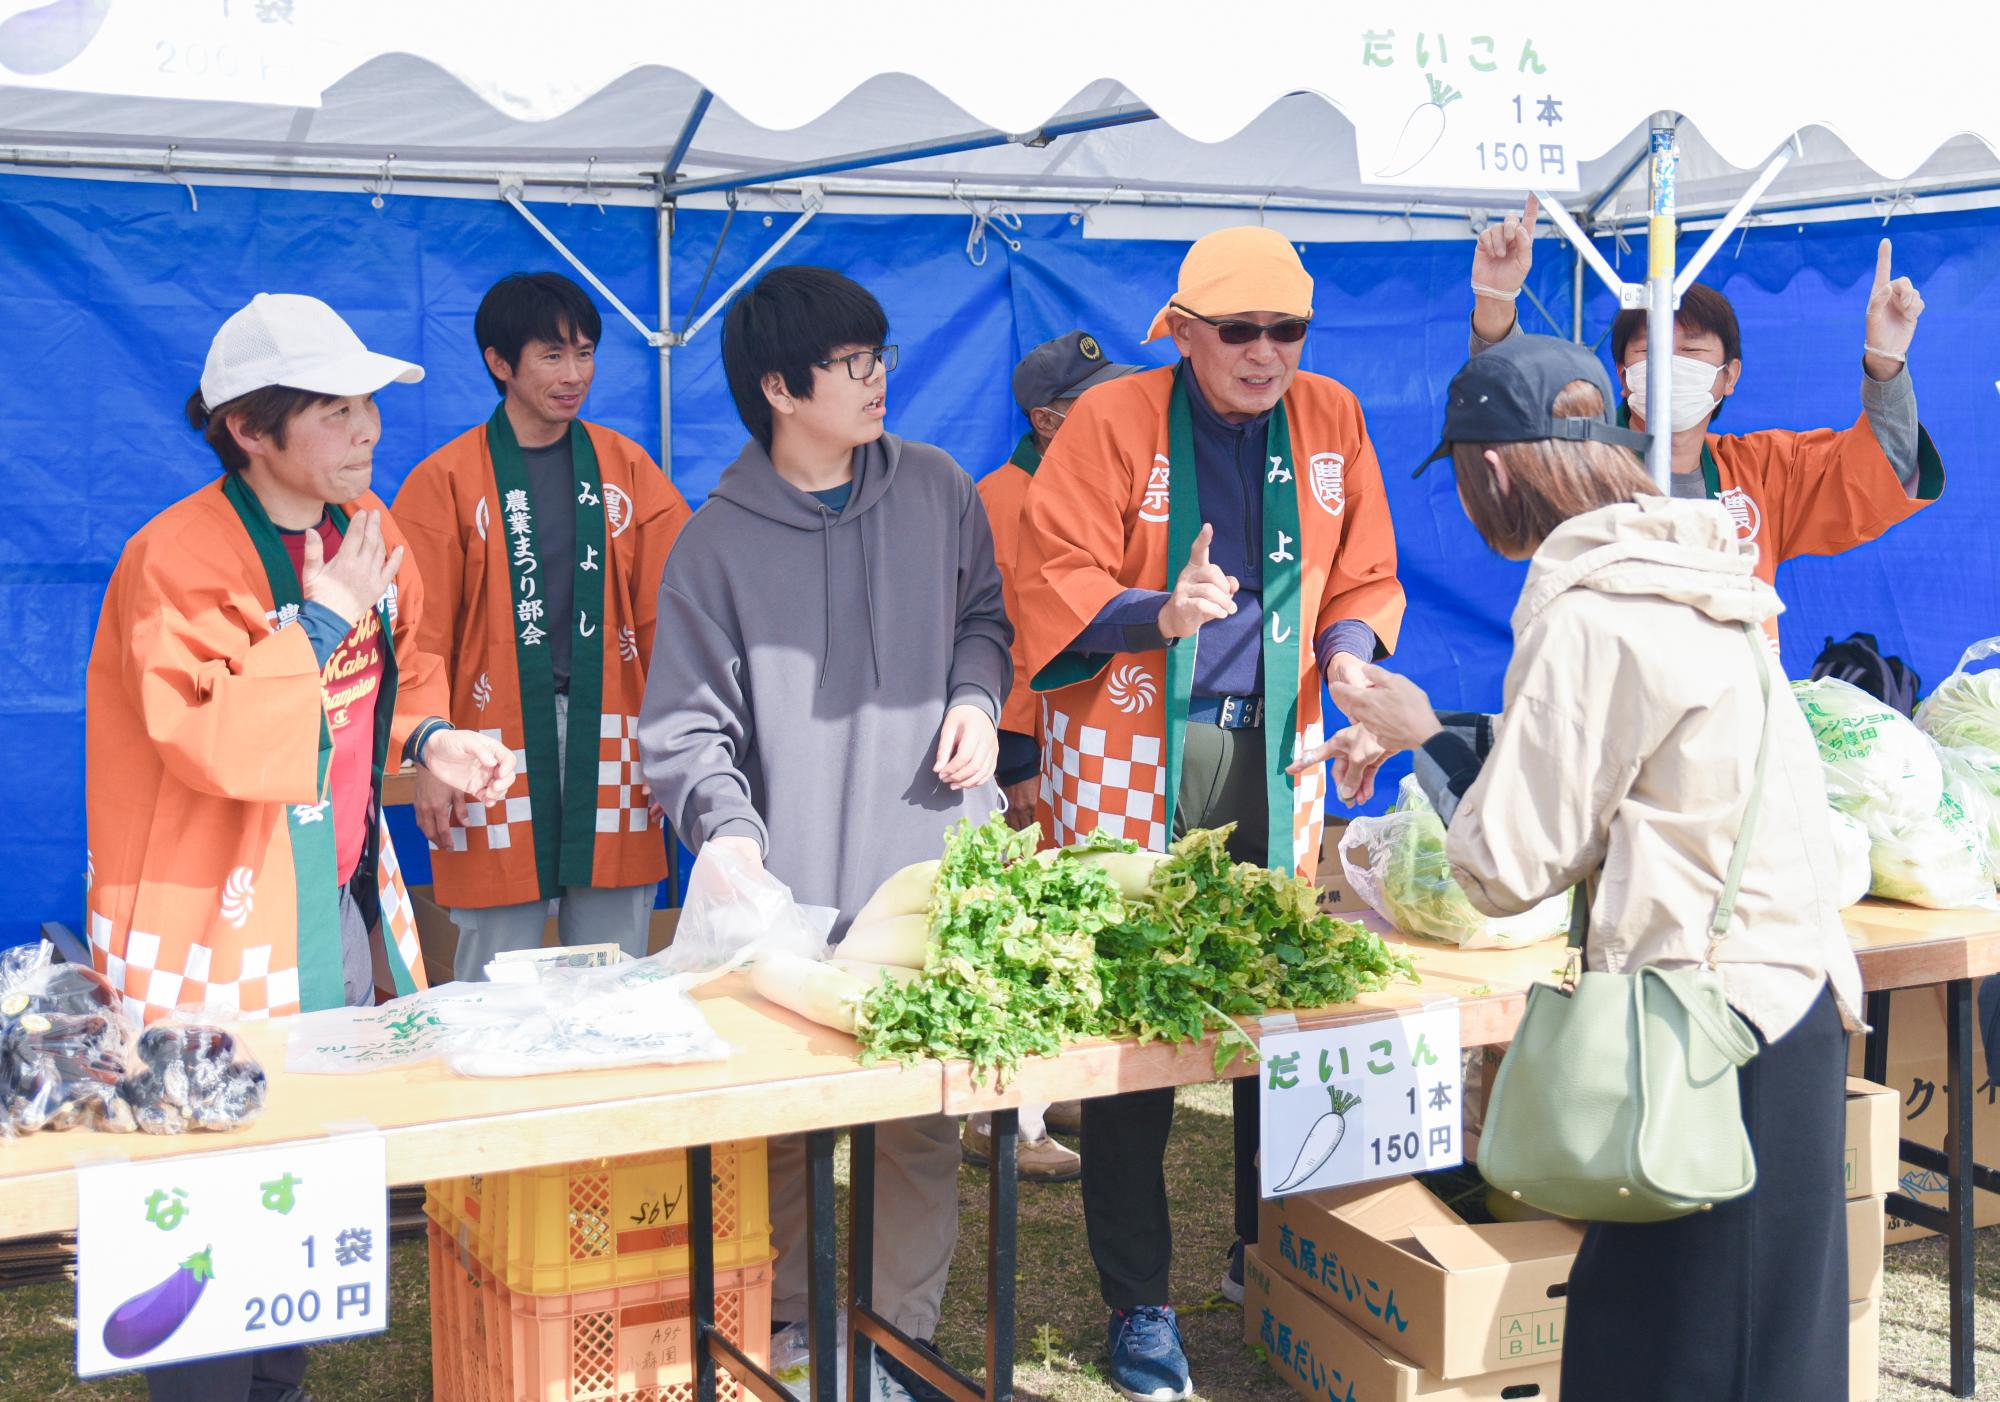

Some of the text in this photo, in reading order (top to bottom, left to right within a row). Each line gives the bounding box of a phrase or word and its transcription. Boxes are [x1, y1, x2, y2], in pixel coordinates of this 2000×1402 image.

[1362, 29, 1547, 75] だいこん
[1512, 95, 1563, 127] 1本
[1476, 142, 1565, 175] 150円
[505, 489, 547, 645] 農業まつり部会
[577, 481, 600, 637] みよし
[1267, 456, 1294, 643] みよし
[321, 676, 376, 711] hampion
[1267, 1033, 1438, 1091] だいこん
[1406, 1081, 1452, 1116] 1本
[1371, 1125, 1452, 1166] 150円
[144, 1172, 303, 1231] なす
[302, 1227, 372, 1267] 1袋
[1278, 1223, 1408, 1334] 高原だいこん
[245, 1281, 371, 1332] 200円
[1509, 1319, 1560, 1345] A LL
[1510, 1340, 1522, 1354] B
